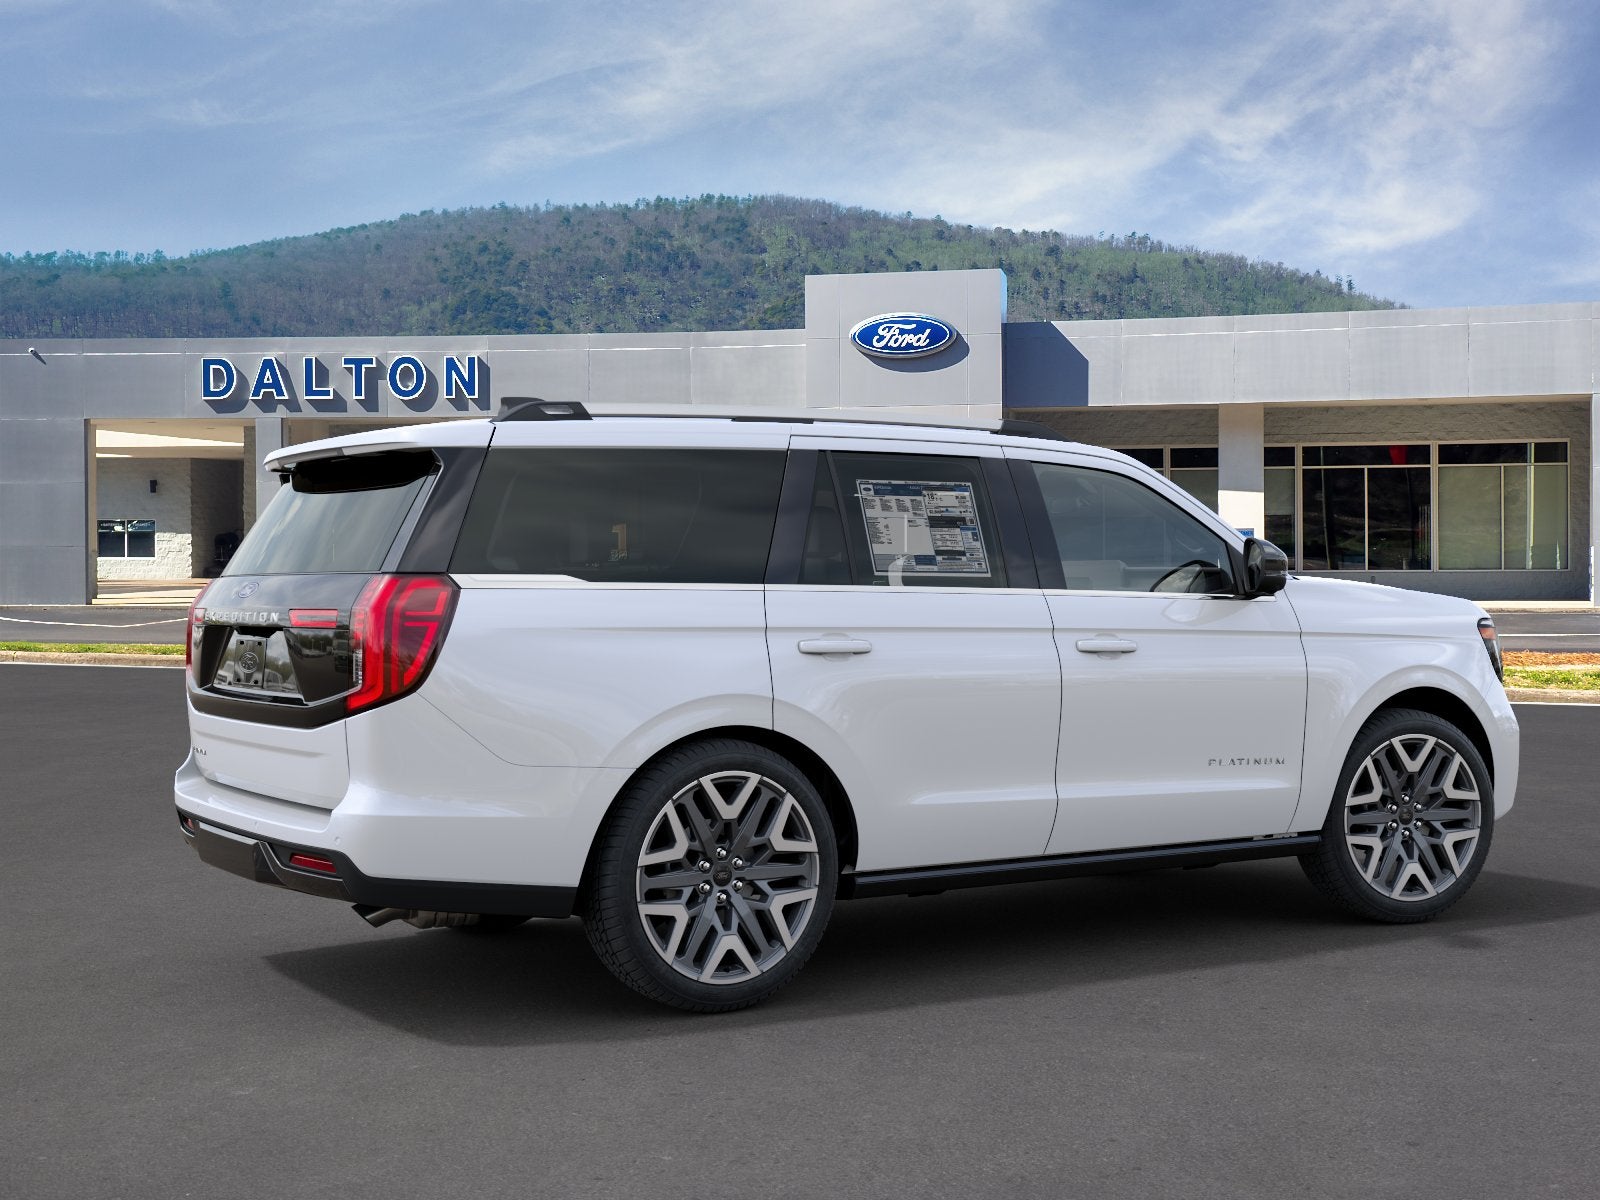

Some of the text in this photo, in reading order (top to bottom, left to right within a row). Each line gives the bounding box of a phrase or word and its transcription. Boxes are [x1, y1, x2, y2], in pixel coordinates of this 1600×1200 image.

[872, 323, 932, 348] Ford
[201, 355, 479, 400] DALTON
[1207, 757, 1285, 767] PLATINUM
